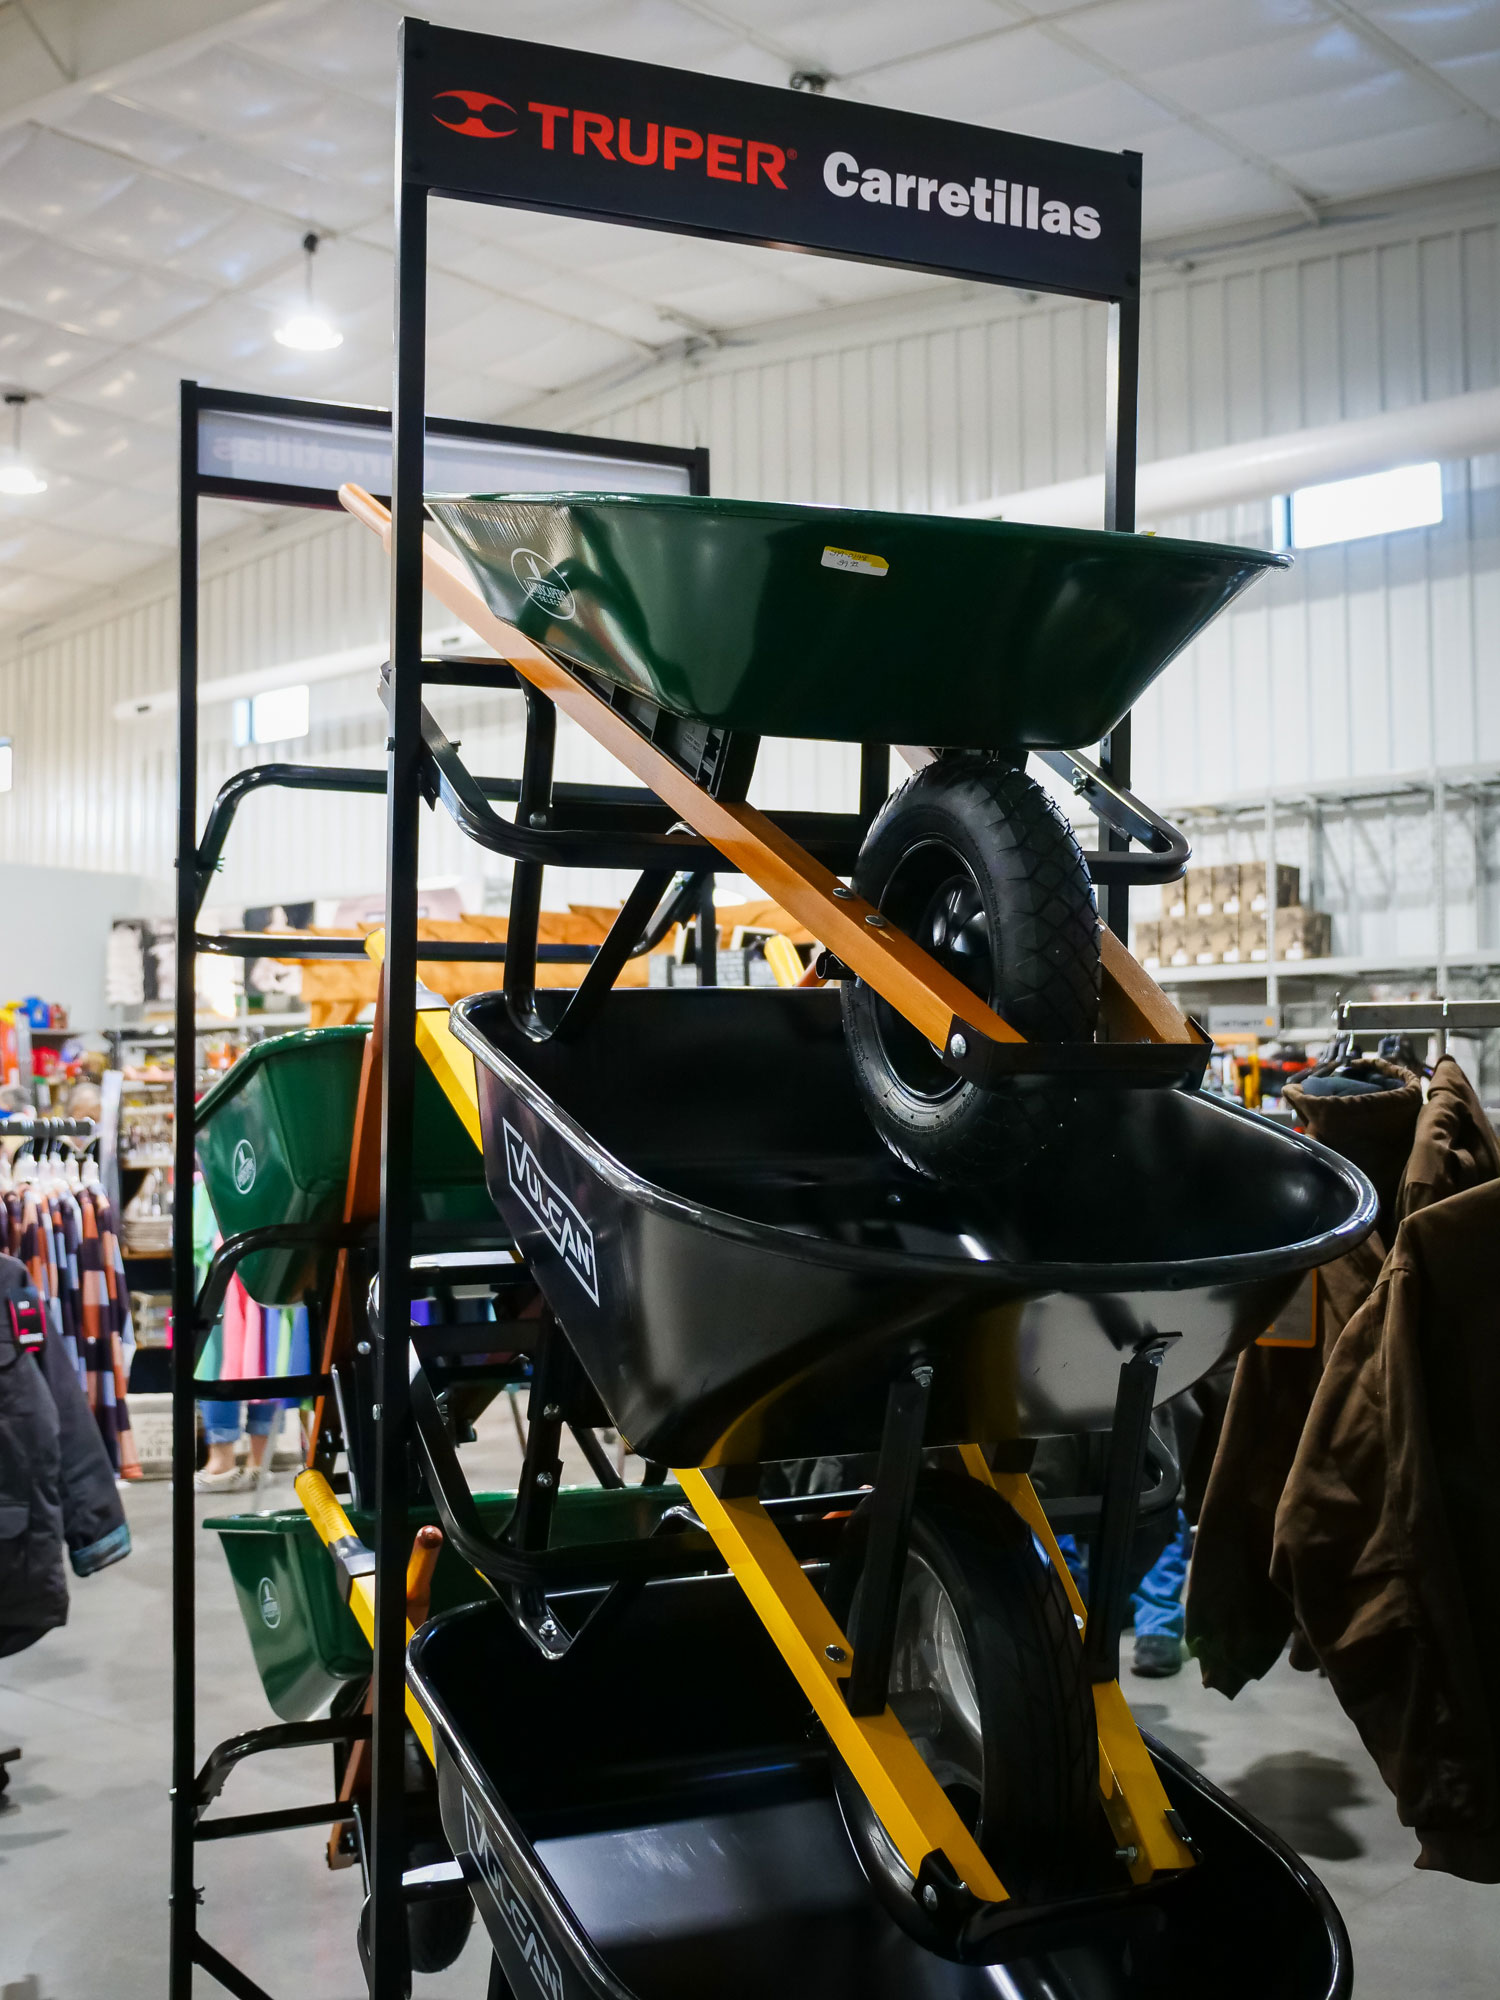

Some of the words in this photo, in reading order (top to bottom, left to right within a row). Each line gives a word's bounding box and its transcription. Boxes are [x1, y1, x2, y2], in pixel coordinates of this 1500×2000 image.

[528, 103, 787, 189] TRUPER
[823, 151, 1101, 240] Carretillas
[509, 1140, 594, 1277] VULCAN
[469, 1814, 561, 2000] VULCAN
